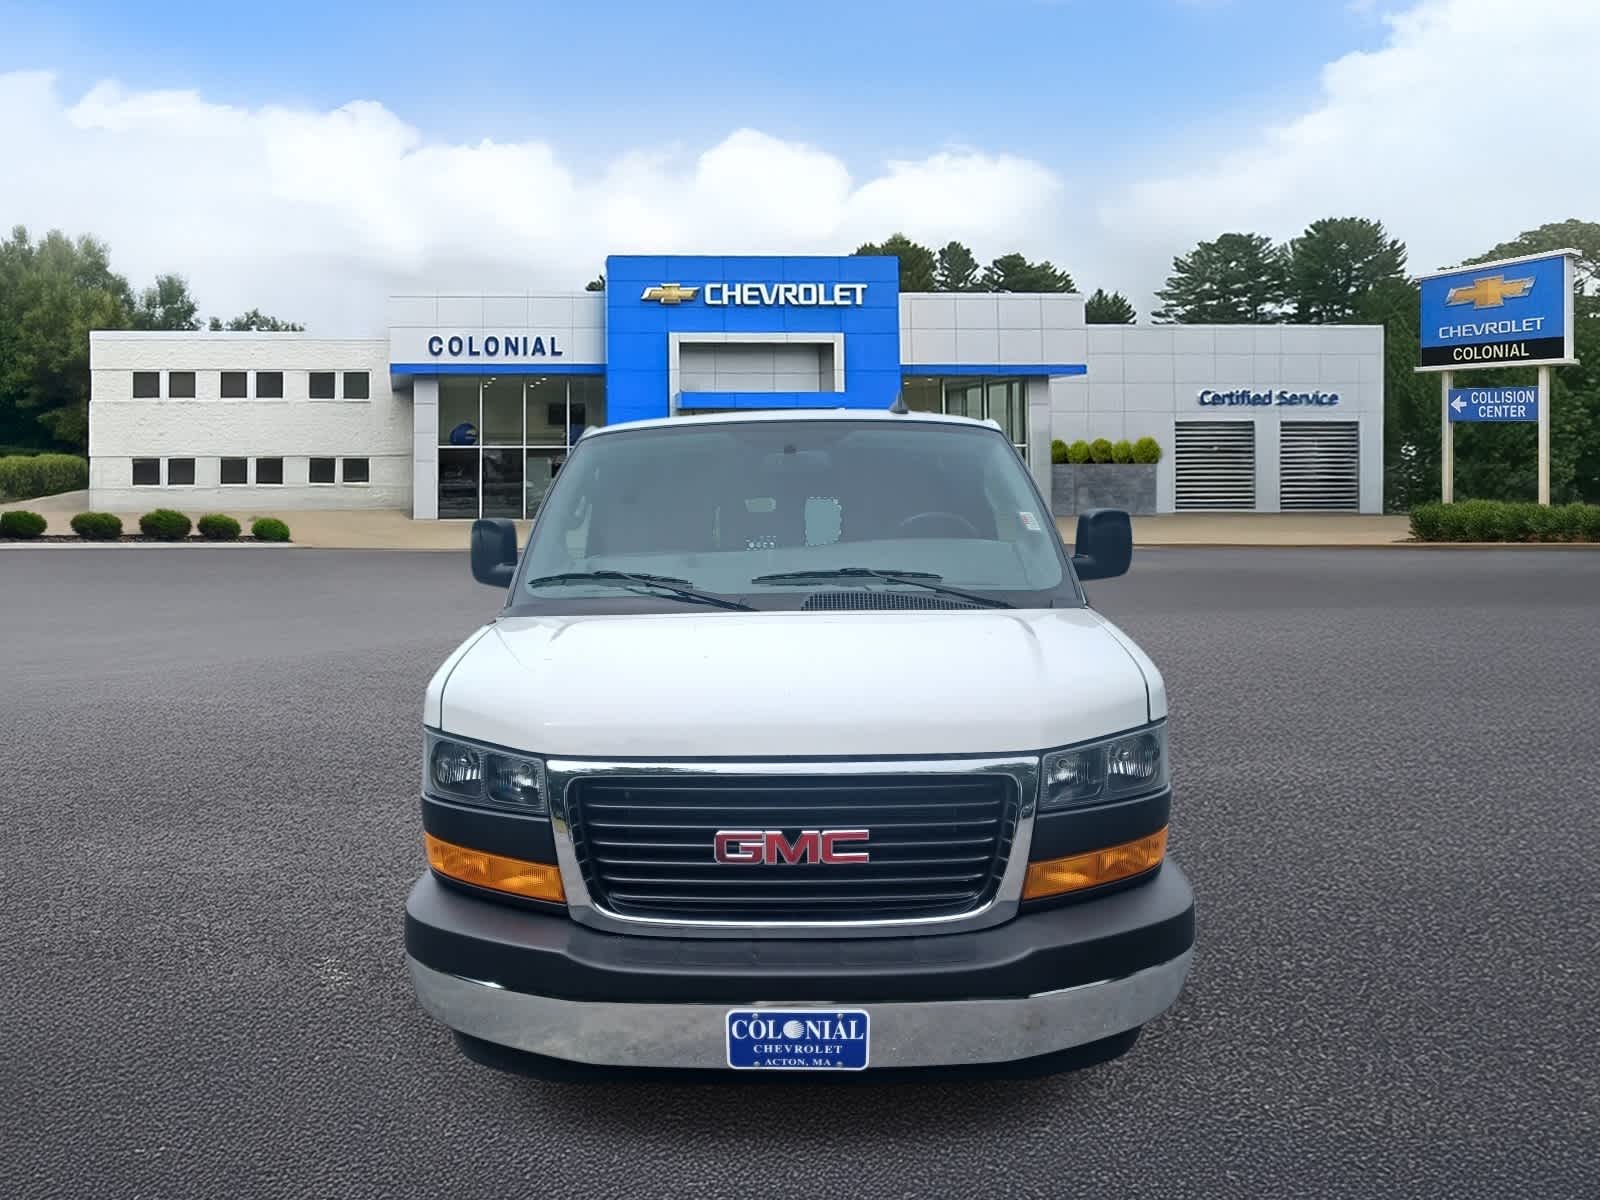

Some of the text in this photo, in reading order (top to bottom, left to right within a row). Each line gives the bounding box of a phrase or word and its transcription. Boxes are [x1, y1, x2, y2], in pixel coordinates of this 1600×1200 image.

[704, 283, 867, 307] CHEVROLET
[1438, 316, 1545, 340] CHEVROLET
[428, 335, 564, 357] COLONIAL
[1452, 343, 1530, 361] COLONIAL
[1199, 390, 1338, 406] Certified Service
[1471, 391, 1535, 404] COLLISION
[1478, 405, 1526, 418] CENTER
[714, 830, 870, 865] GMC
[731, 1019, 864, 1040] COLONIAL
[753, 1044, 843, 1054] CHEVROLET
[764, 1058, 831, 1067] ACTON, MA
